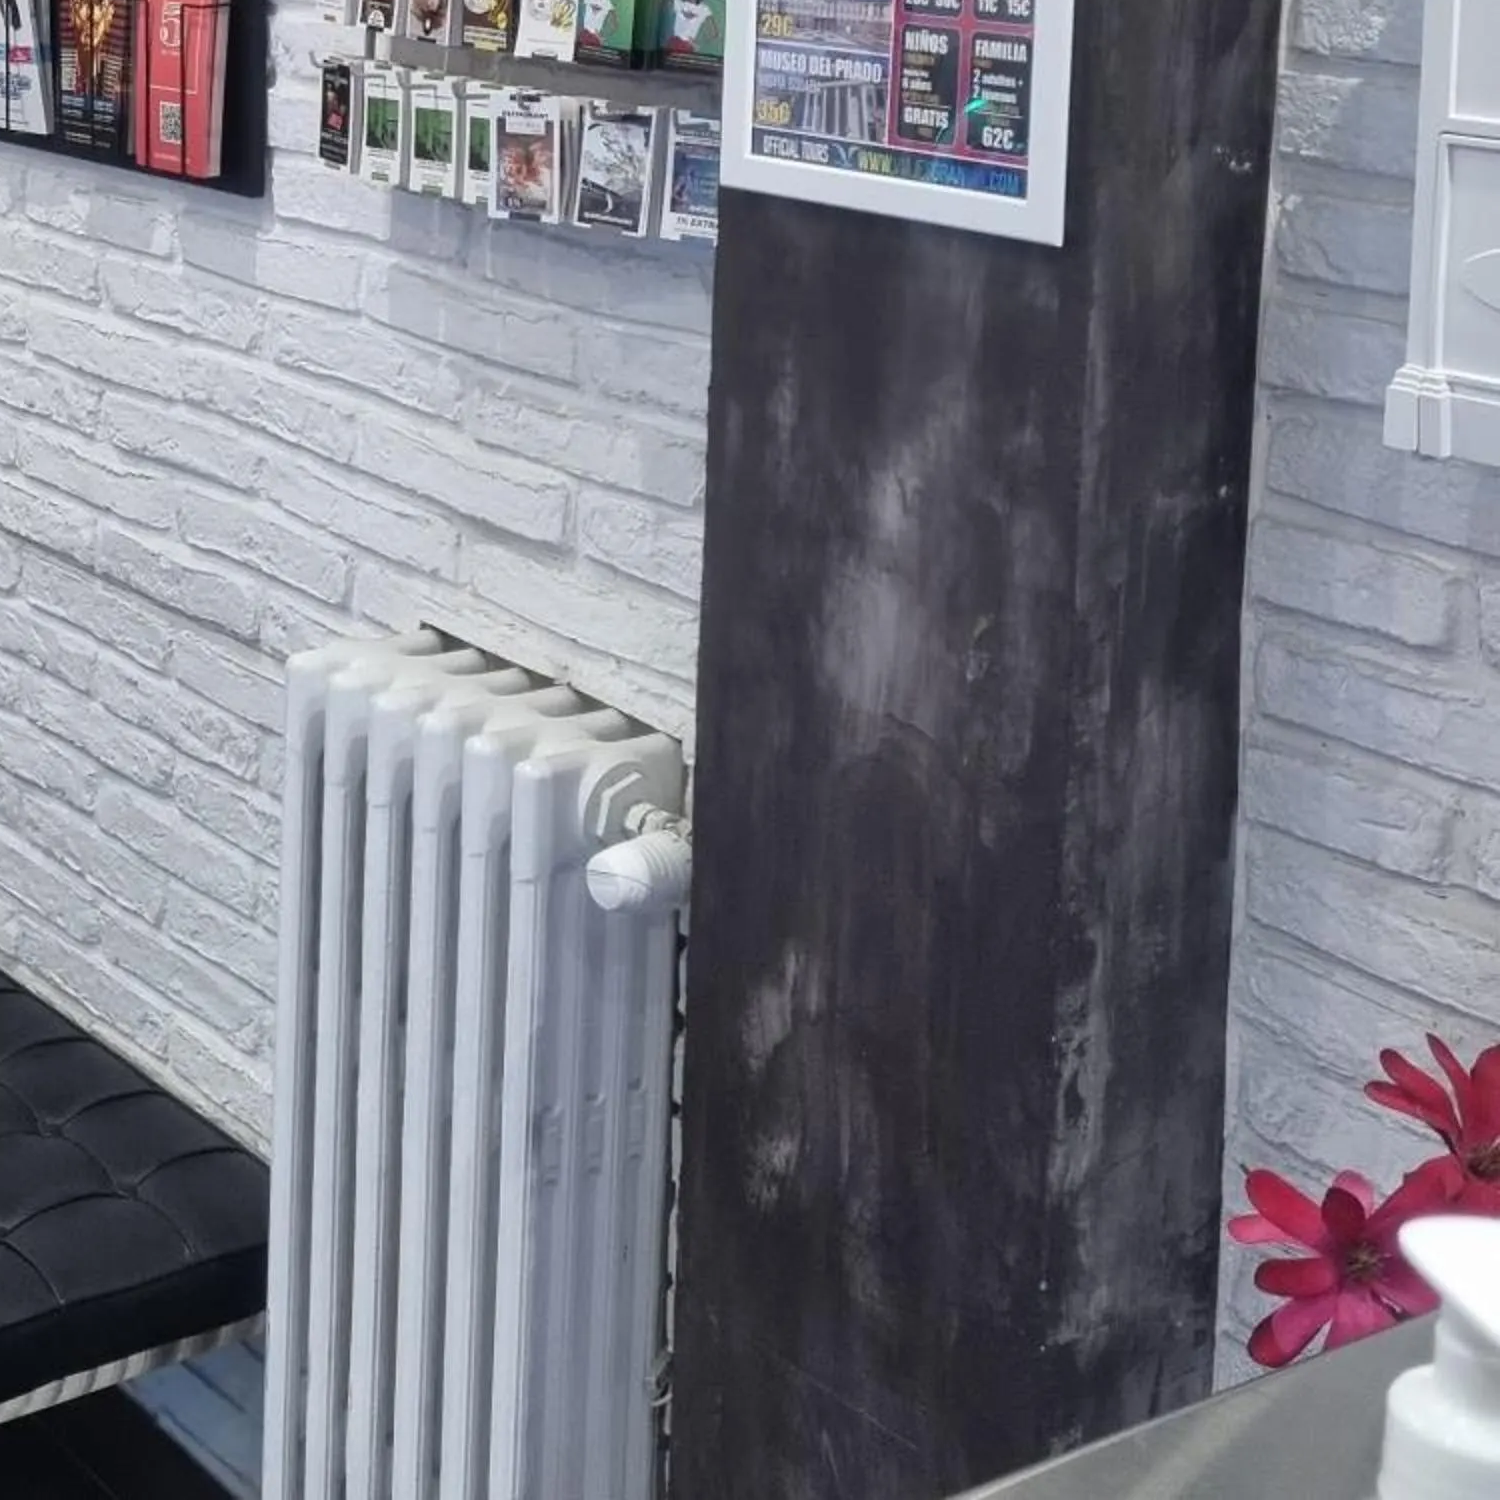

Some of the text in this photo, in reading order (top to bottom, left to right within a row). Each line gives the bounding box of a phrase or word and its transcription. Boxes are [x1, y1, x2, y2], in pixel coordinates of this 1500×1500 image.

[905, 28, 949, 56] NIÑOS
[975, 37, 1028, 63] FAMILIA
[759, 49, 807, 75] MUSEO
[809, 56, 833, 79] DEL
[834, 59, 882, 85] PRADO
[904, 105, 950, 131] GRATIS
[982, 126, 1015, 152] 62€
